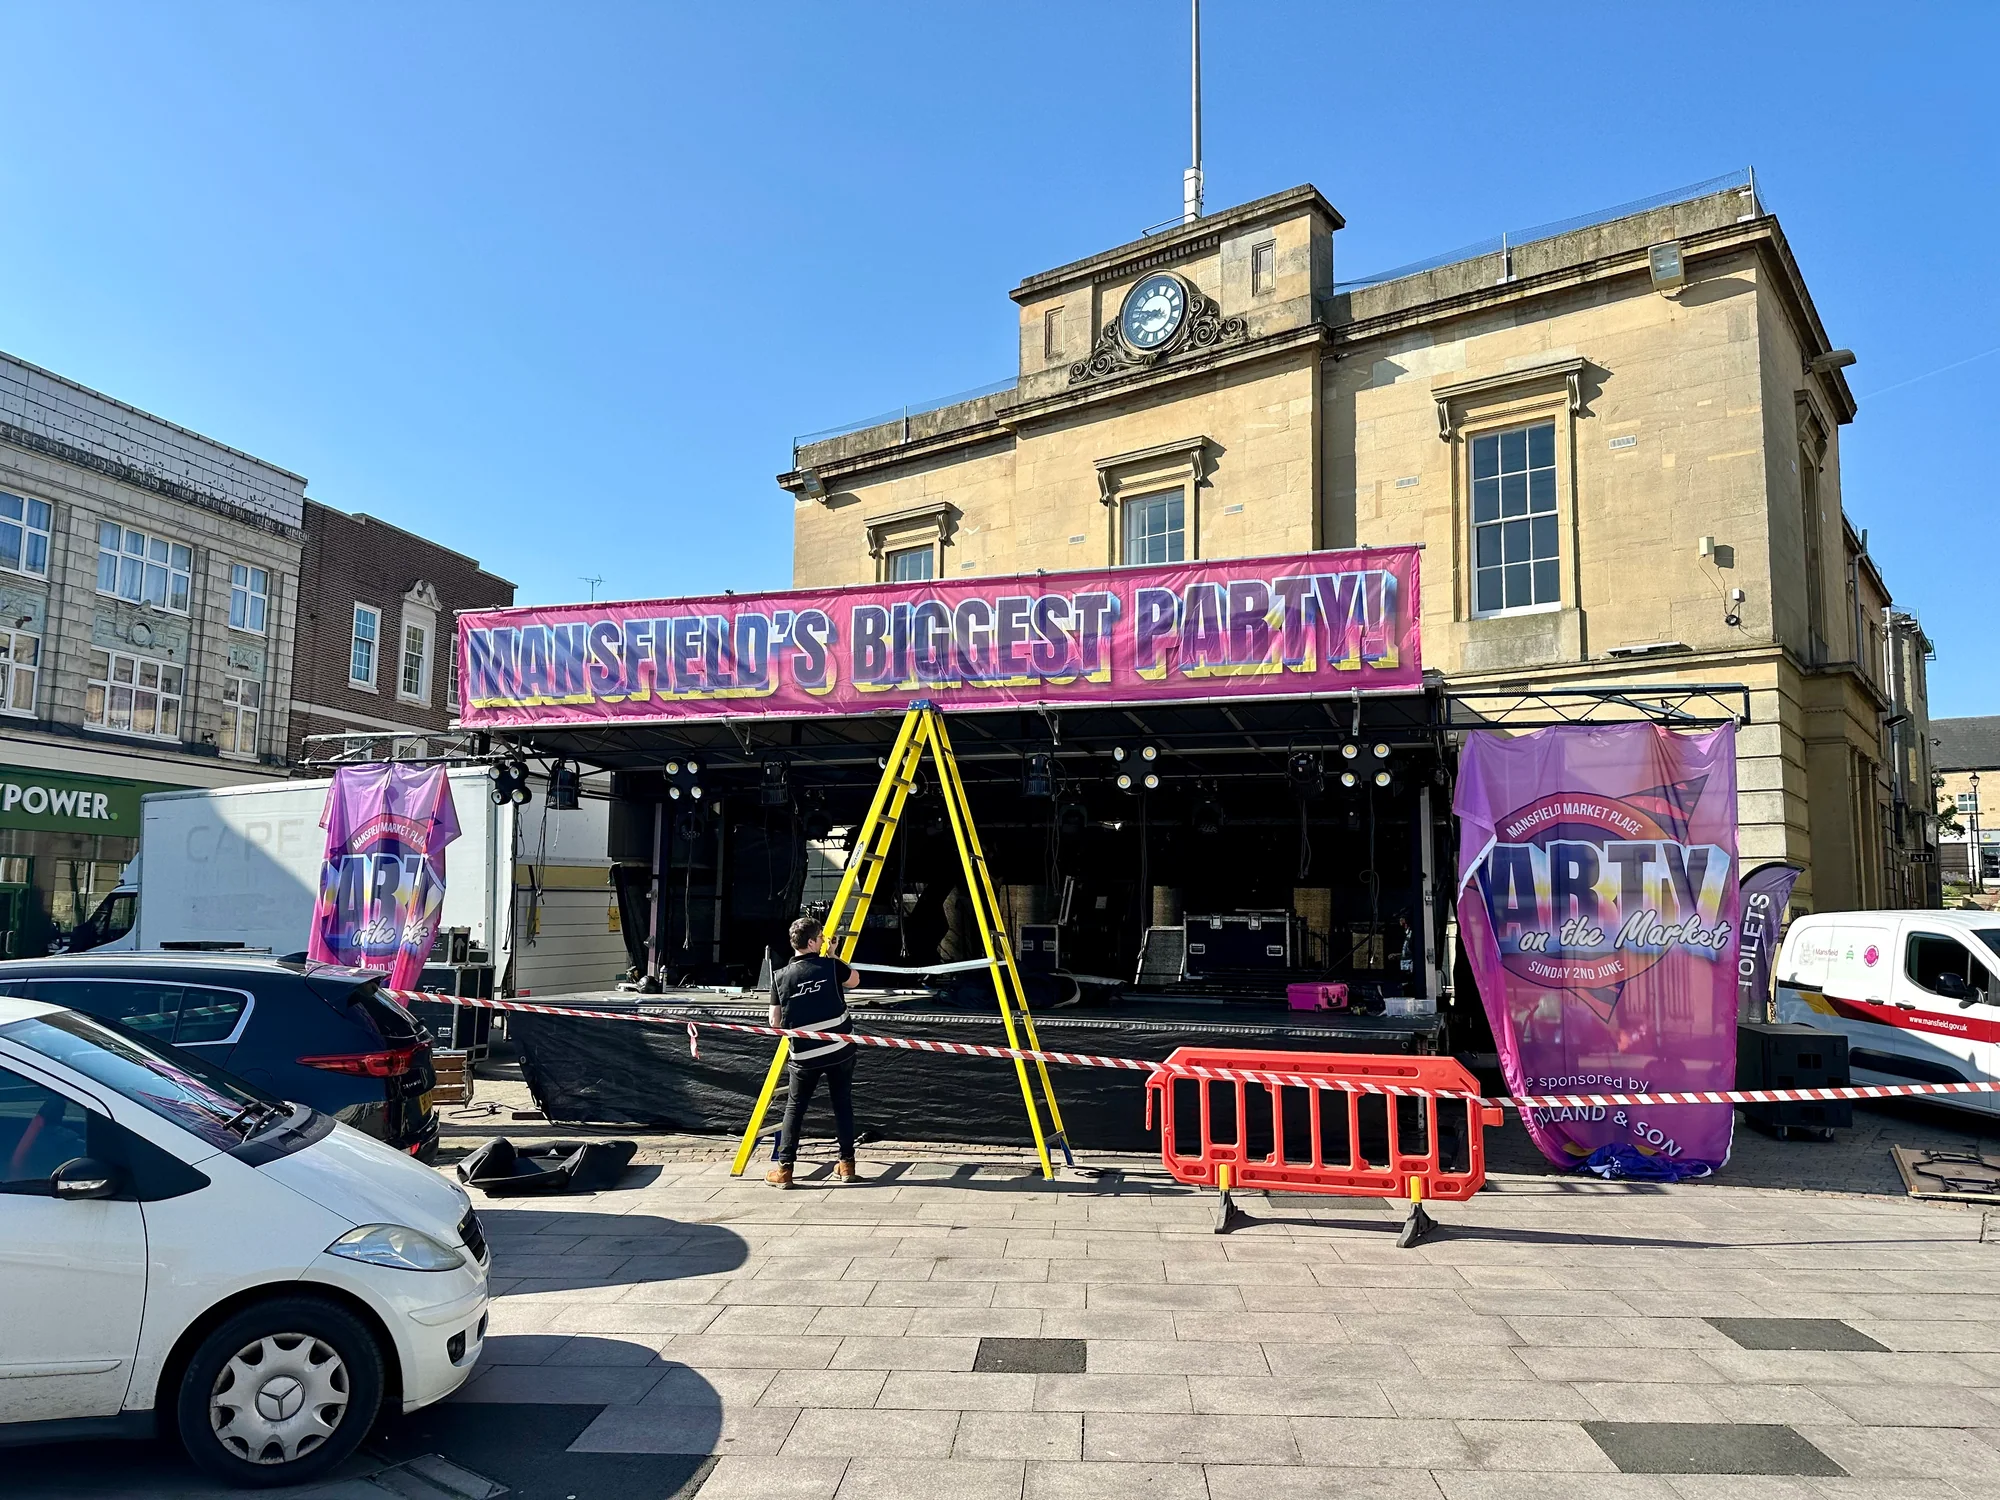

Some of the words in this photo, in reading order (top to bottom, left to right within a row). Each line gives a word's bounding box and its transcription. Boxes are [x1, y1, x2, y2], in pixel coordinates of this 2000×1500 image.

[468, 606, 837, 709] MANSFIELD'S
[850, 591, 1120, 693] BIGGEST
[1134, 569, 1400, 681] PARTY!
[0, 783, 118, 820] POWER.
[352, 823, 380, 850] MANSFIEL
[381, 822, 410, 836] MARKET
[1506, 805, 1561, 838] MANSFIELD
[1563, 803, 1610, 820] MARKET
[1608, 810, 1643, 836] PLACE
[1519, 931, 1549, 952] on
[1560, 915, 1605, 948] the
[1614, 909, 1732, 950] Market
[1528, 961, 1570, 979] SUNDAY
[1573, 967, 1594, 980] 2ND
[1598, 960, 1625, 978] JUNE
[1909, 1016, 1968, 1031] www.mansfield.gov.uk
[1539, 1074, 1622, 1090] sponsored
[1629, 1077, 1649, 1093] by
[1612, 1110, 1628, 1128] &
[1634, 1121, 1682, 1157] SON
